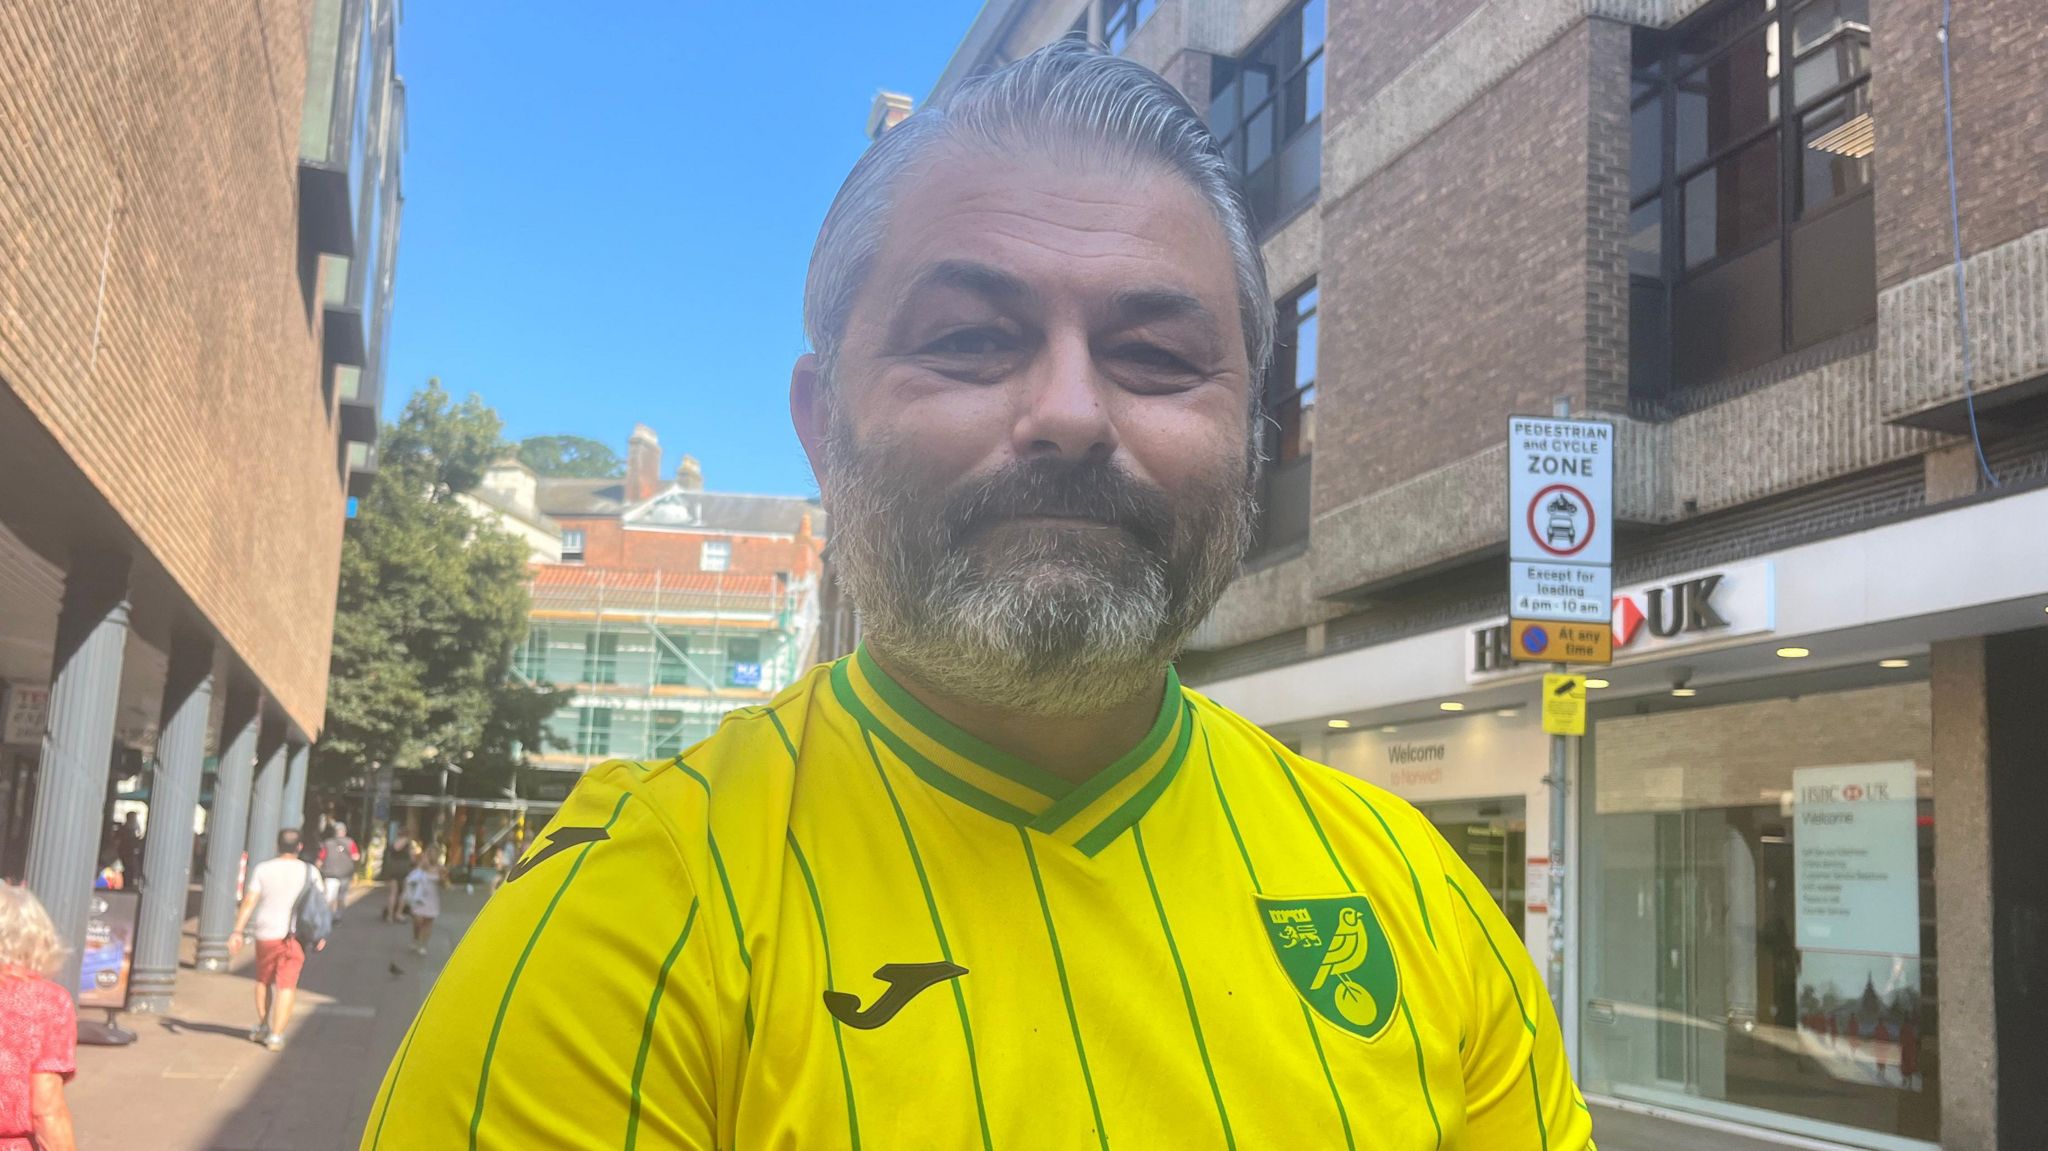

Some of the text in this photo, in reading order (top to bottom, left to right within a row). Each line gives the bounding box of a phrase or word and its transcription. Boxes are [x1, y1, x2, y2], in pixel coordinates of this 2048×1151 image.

[1515, 423, 1608, 440] PEDESTRIAN
[1523, 438, 1599, 454] and CYCLE
[1528, 454, 1593, 477] ZONE
[1527, 567, 1595, 583] Except for
[1537, 583, 1585, 598] loading
[1520, 598, 1528, 608] 4
[1532, 600, 1552, 612] pm
[1563, 601, 1577, 612] 10
[1580, 604, 1599, 613] am
[1645, 574, 1730, 637] UK
[1558, 626, 1600, 645] At any
[1565, 643, 1594, 656] time
[1388, 742, 1445, 764] Welcome
